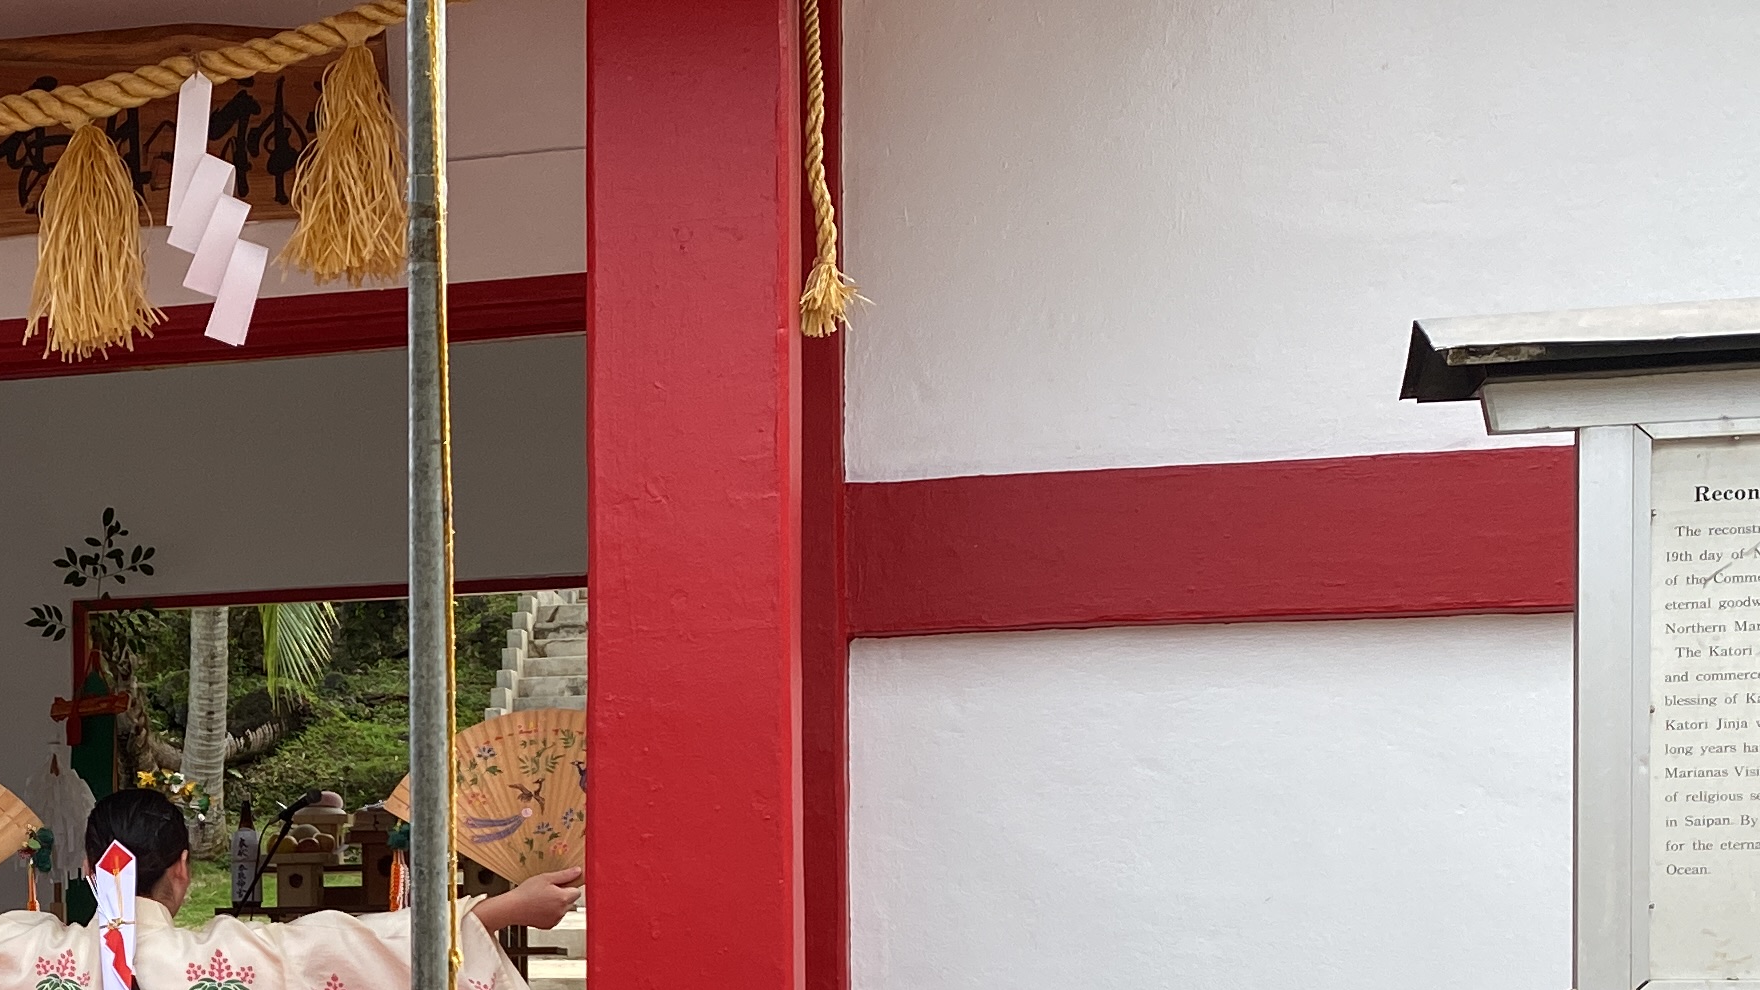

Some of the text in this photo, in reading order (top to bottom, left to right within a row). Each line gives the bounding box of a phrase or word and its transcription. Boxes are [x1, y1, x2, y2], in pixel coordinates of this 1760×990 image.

[1694, 485, 1760, 503] Recon
[1674, 526, 1701, 537] The
[1666, 550, 1692, 562] 19th
[1699, 549, 1723, 562] day
[1731, 547, 1745, 560] of
[1665, 574, 1678, 586] of
[1664, 597, 1711, 610] eternal
[1665, 622, 1726, 635] Northern
[1674, 645, 1753, 658] The Katori
[1664, 671, 1689, 683] and
[1664, 694, 1717, 707] blessing
[1724, 692, 1739, 704] of
[1665, 719, 1709, 731] Katori
[1716, 718, 1748, 731] Jinja
[1665, 743, 1693, 756] long
[1700, 744, 1737, 756] years
[1664, 767, 1729, 779] Marianas
[1664, 791, 1678, 803] of
[1685, 790, 1743, 804] religious
[1665, 815, 1678, 828] in
[1740, 814, 1759, 827] By
[1665, 840, 1685, 852] for
[1692, 839, 1713, 851] the
